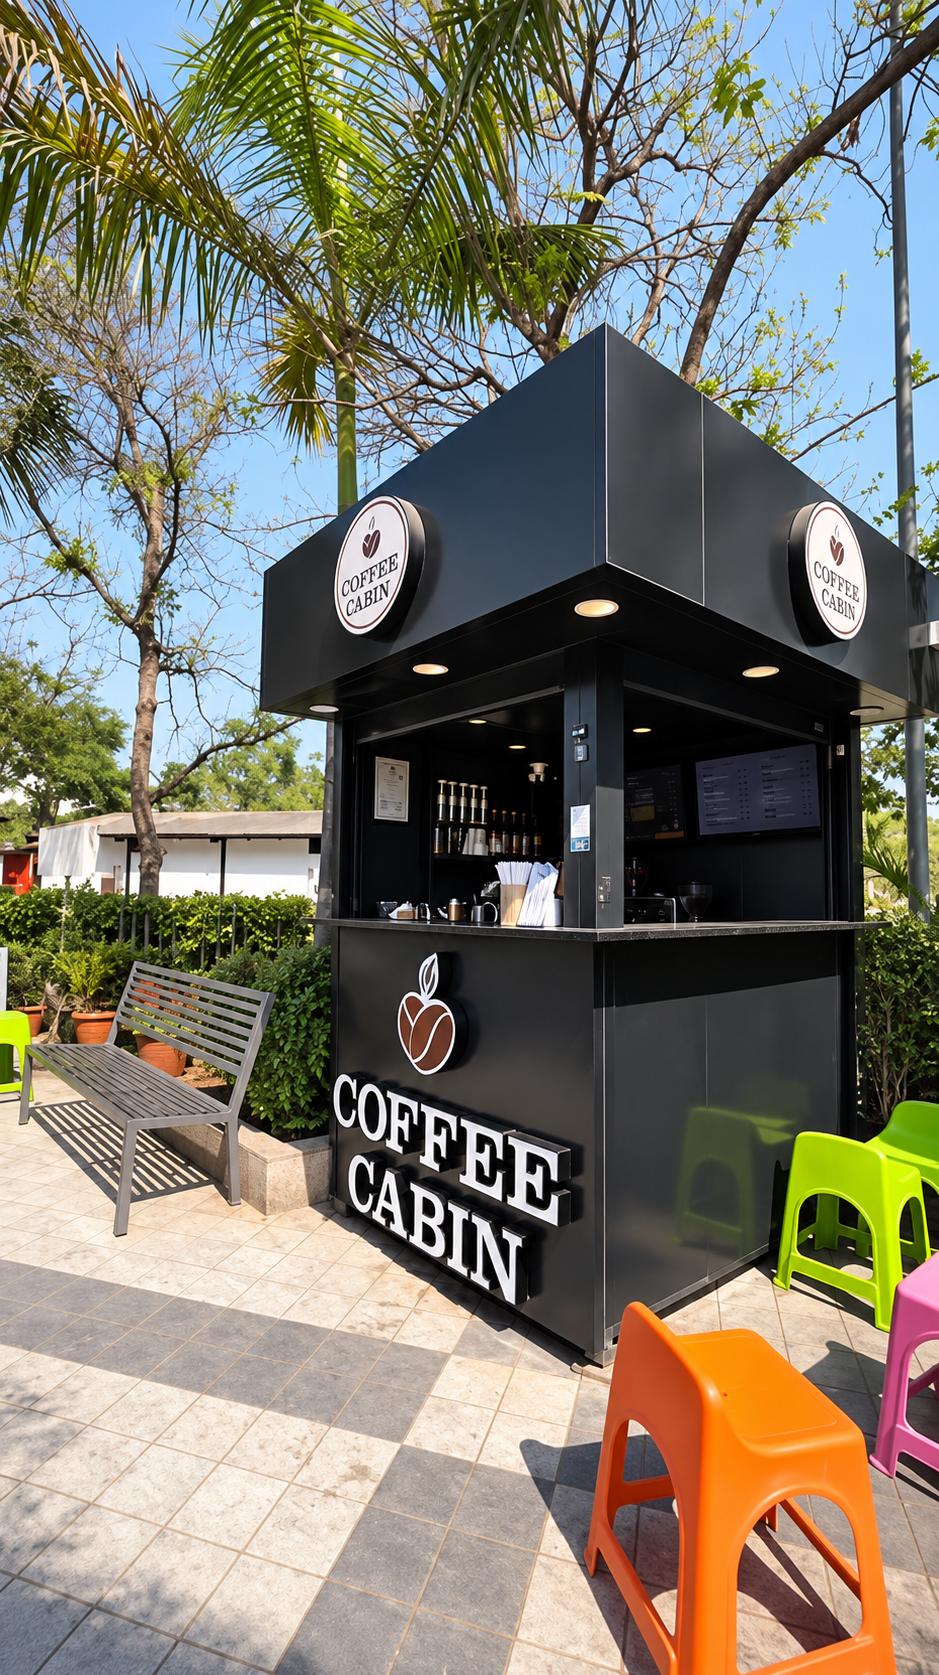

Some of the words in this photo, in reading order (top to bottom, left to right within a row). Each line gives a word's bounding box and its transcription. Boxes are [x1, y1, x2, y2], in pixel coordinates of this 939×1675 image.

[341, 552, 399, 597] COFFEE
[813, 560, 860, 603] COFFEE
[346, 579, 391, 617] CABIN
[821, 588, 856, 622] CABIN
[333, 1073, 561, 1228] COFFEE
[347, 1154, 524, 1306] CABIN
